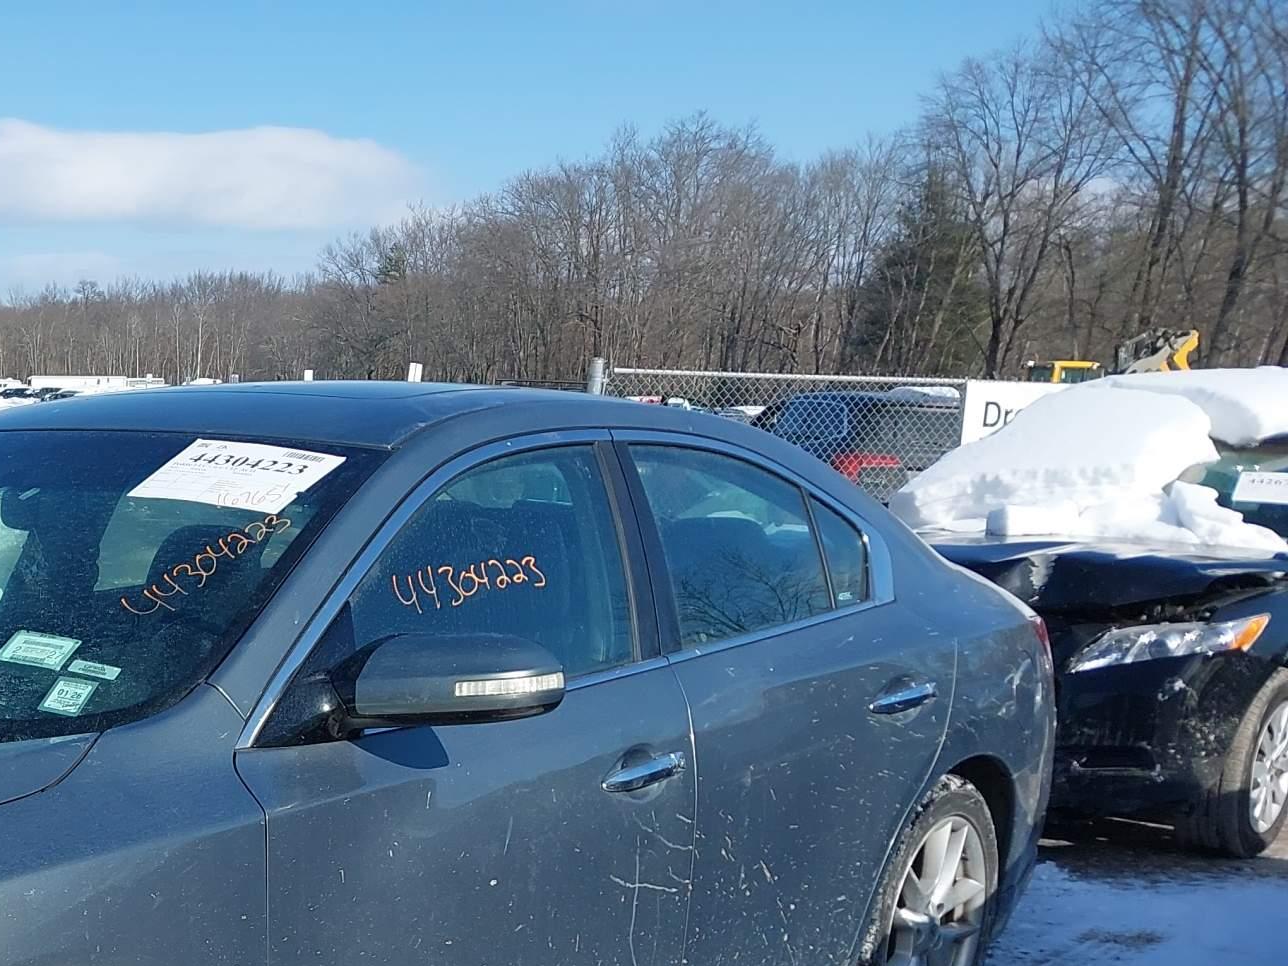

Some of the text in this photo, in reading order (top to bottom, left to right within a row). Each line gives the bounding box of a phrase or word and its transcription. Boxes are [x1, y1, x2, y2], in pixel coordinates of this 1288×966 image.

[983, 402, 1023, 427] Dr
[189, 452, 310, 475] 44304223
[120, 514, 291, 615] 44304223
[392, 555, 546, 614] 44304223
